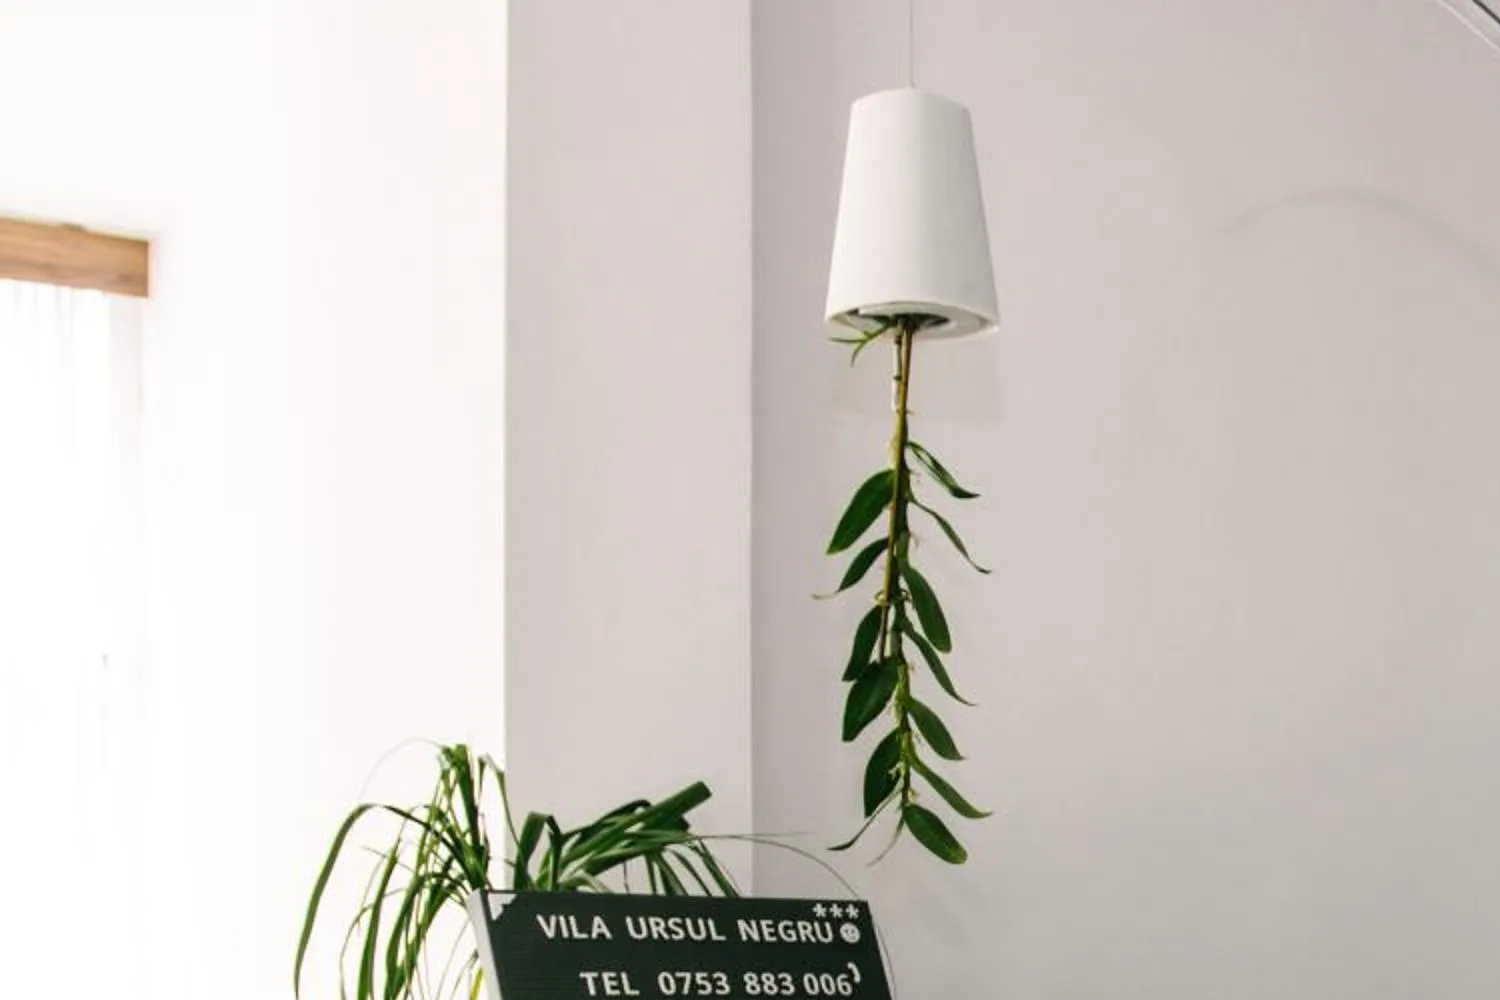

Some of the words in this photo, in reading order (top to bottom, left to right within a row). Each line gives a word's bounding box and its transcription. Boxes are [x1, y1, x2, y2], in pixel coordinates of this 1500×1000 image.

[536, 914, 613, 940] VILA
[625, 916, 727, 941] URSUL
[737, 919, 834, 943] NEGRU
[579, 971, 640, 997] TEL
[657, 971, 731, 996] 0753
[743, 972, 796, 996] 883
[803, 972, 853, 996] 006
